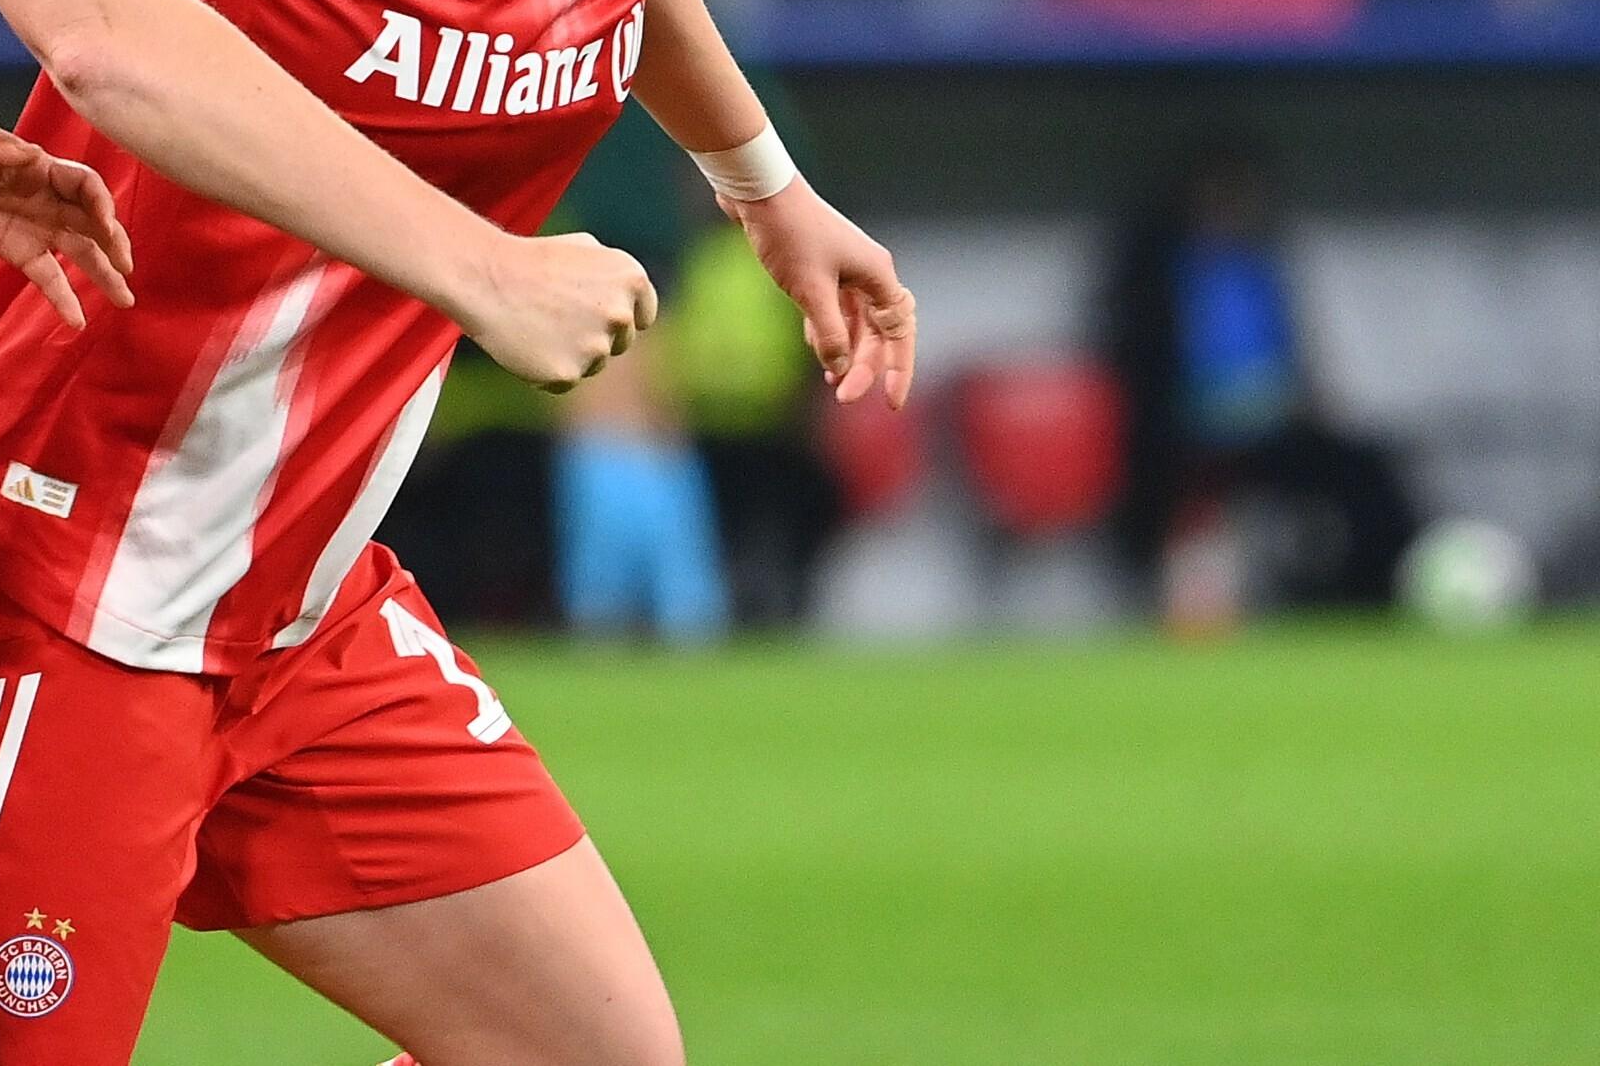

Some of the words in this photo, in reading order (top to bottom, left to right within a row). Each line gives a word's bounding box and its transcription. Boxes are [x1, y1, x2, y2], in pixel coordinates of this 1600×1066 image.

[343, 9, 604, 116] Allianz
[0, 944, 20, 963] FC
[22, 940, 68, 980] BAYERN
